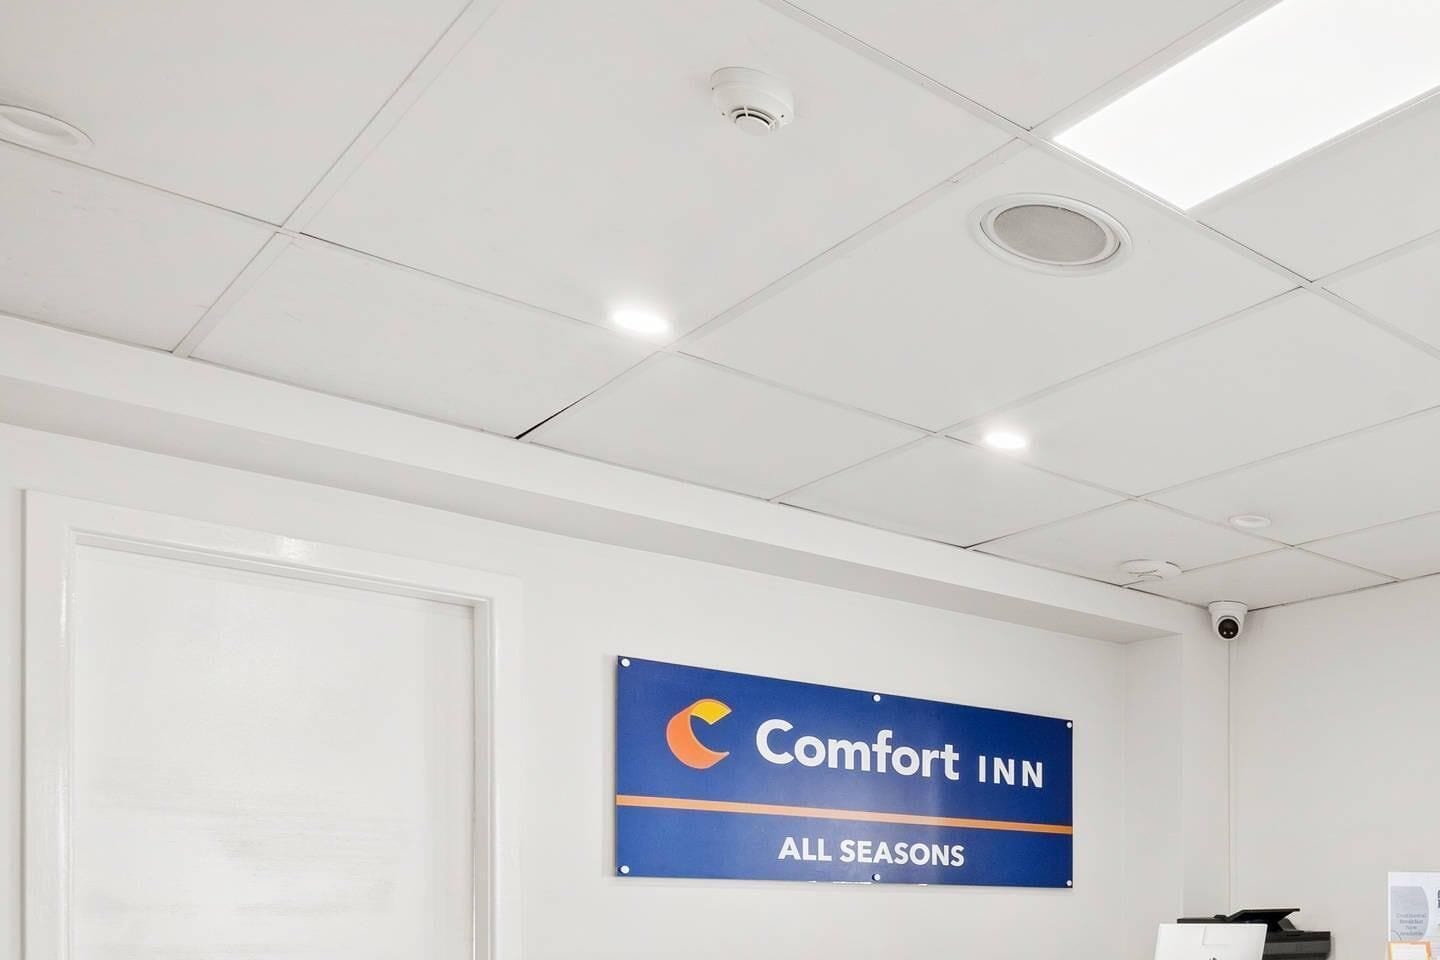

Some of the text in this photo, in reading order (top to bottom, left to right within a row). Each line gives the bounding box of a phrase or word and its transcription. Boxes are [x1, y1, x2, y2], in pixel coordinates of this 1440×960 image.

[755, 718, 1044, 788] Comfort INN
[778, 837, 965, 867] ALL SEASONS
